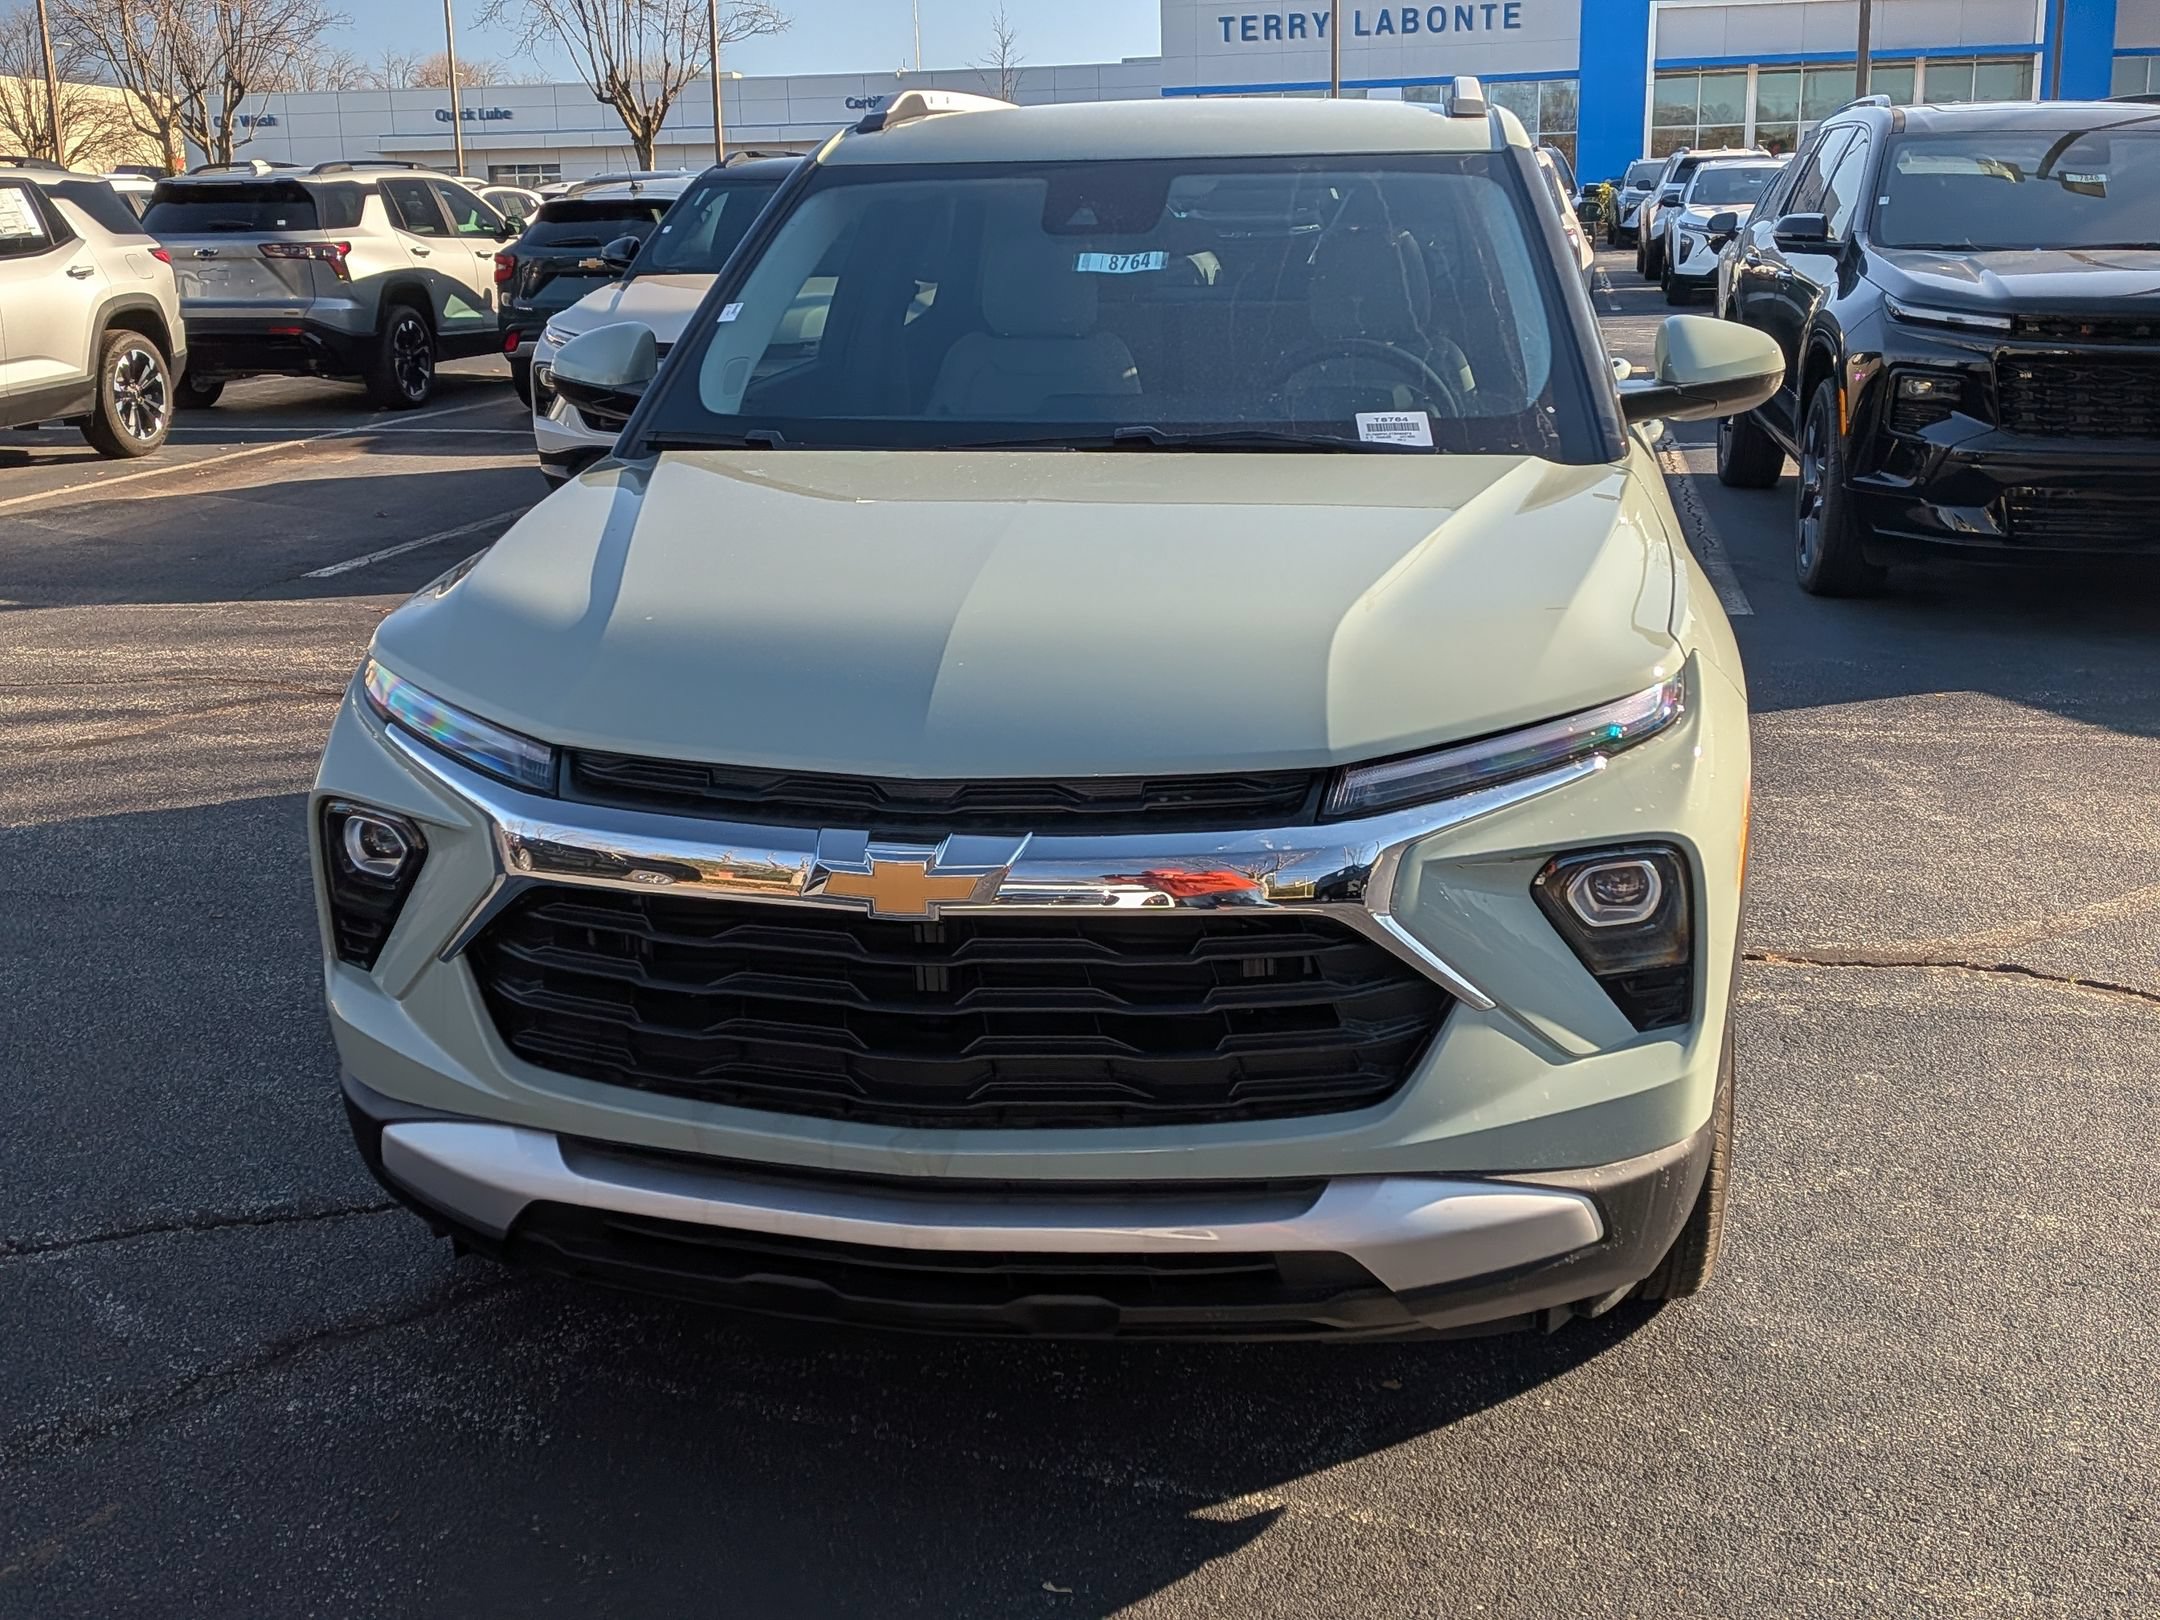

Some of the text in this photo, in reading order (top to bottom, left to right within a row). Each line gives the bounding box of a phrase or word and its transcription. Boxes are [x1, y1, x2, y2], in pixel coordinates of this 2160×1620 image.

[1218, 2, 1521, 42] TERRY LABONTE
[434, 106, 513, 122] Quck Lube
[1108, 253, 1151, 271] 8764
